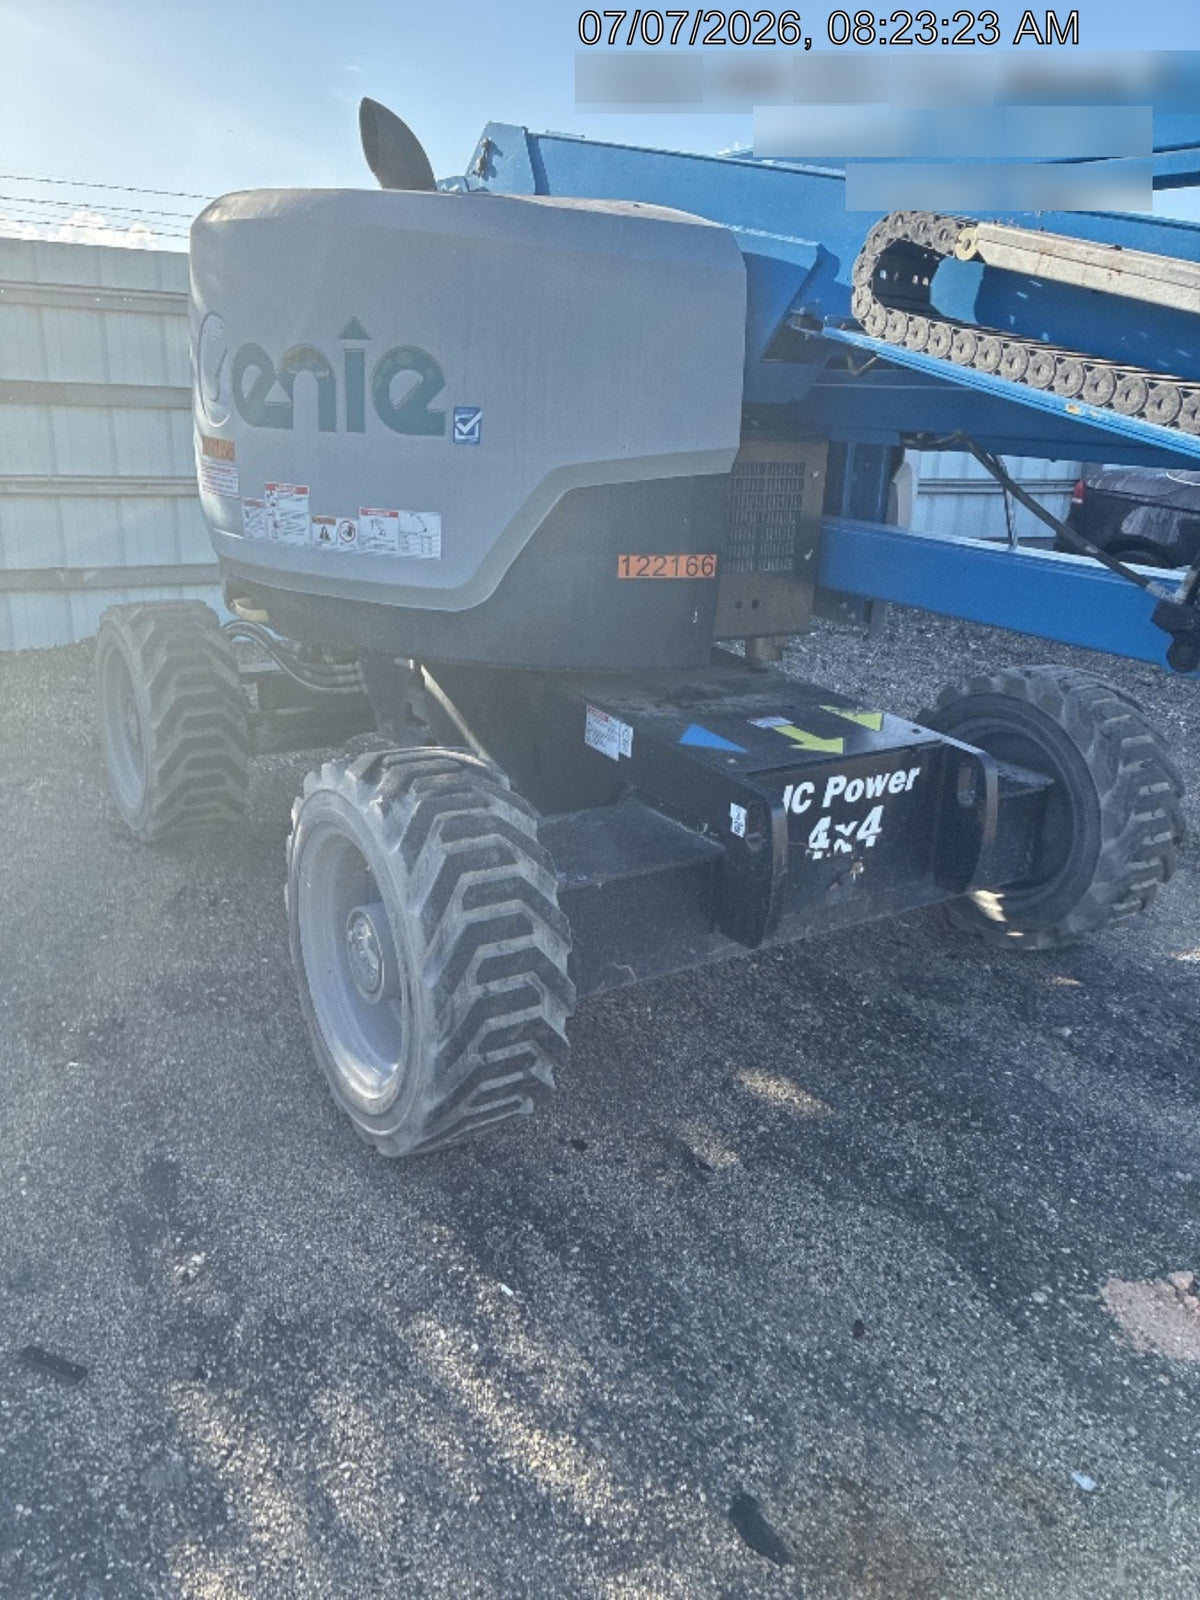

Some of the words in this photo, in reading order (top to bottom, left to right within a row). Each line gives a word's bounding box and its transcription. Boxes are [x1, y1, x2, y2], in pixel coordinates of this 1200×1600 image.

[621, 555, 714, 577] 122166
[822, 767, 921, 808] Power
[806, 805, 885, 860] 4x4
